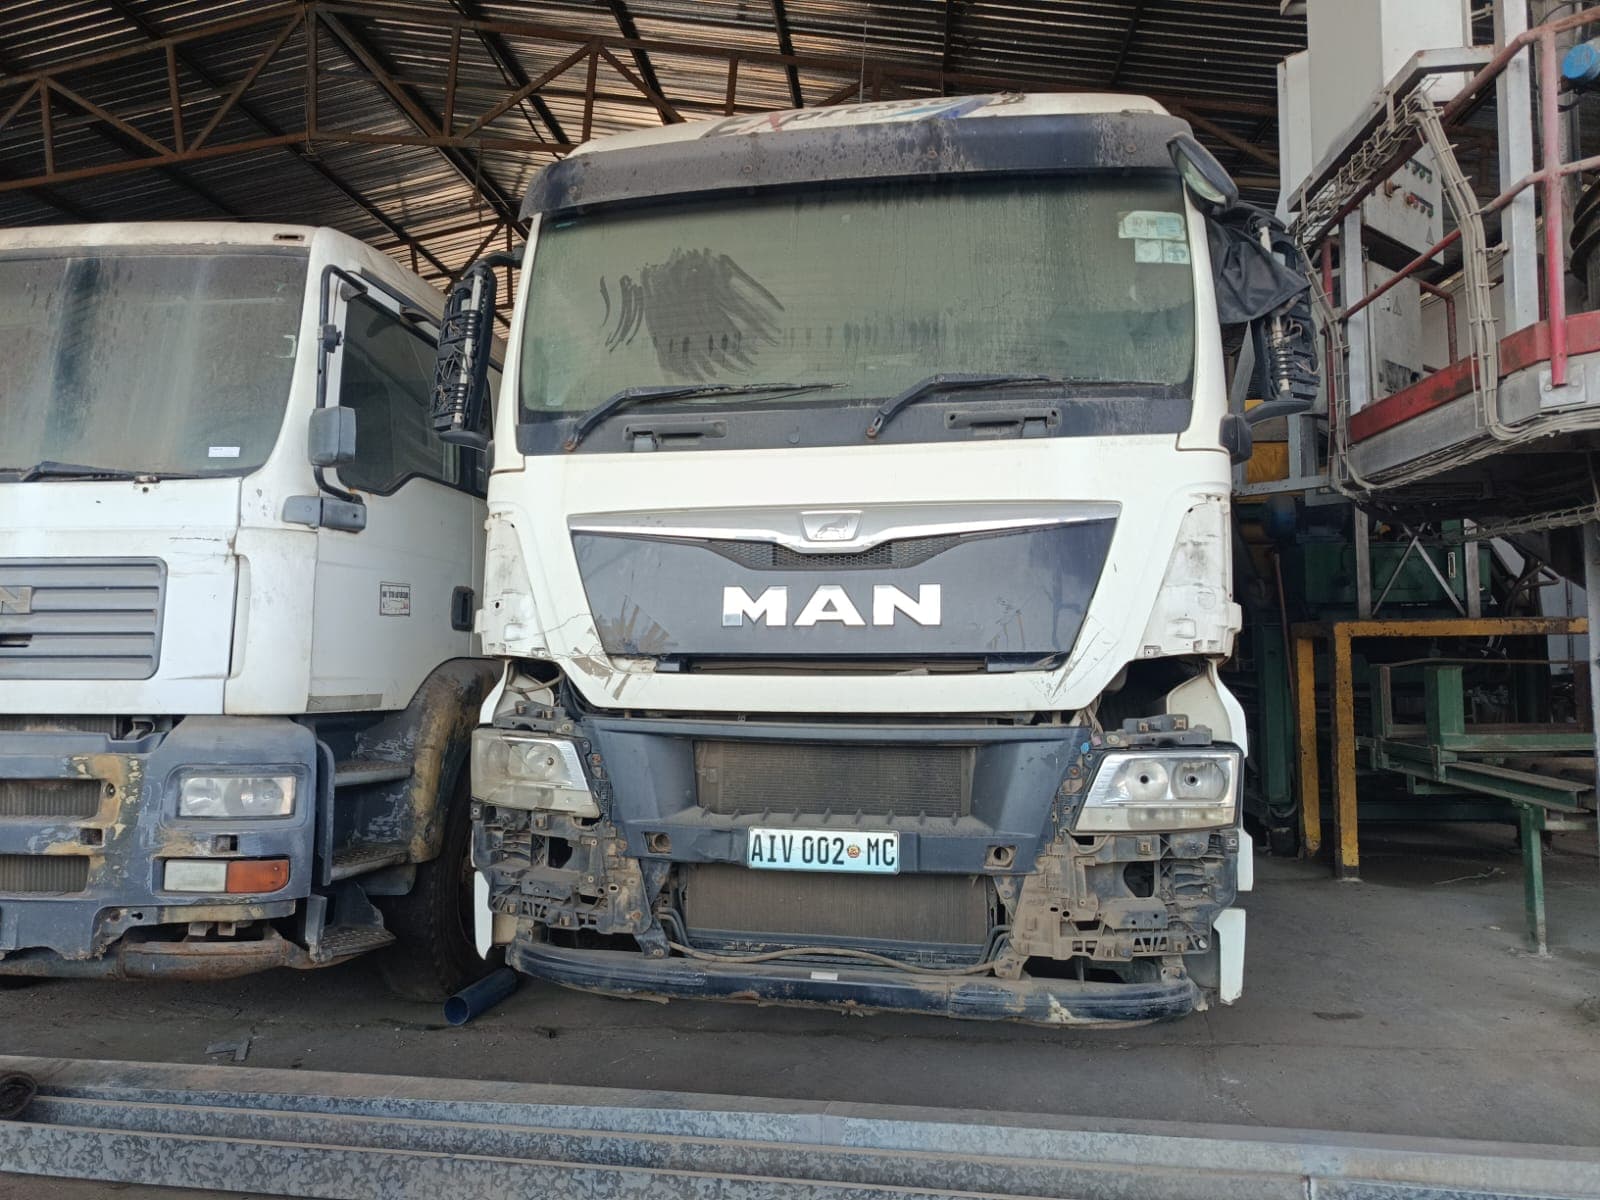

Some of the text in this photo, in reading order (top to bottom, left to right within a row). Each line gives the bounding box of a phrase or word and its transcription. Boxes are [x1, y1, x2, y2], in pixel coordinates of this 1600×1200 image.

[721, 584, 942, 627] MAN
[751, 834, 895, 867] AIV 002 MC
